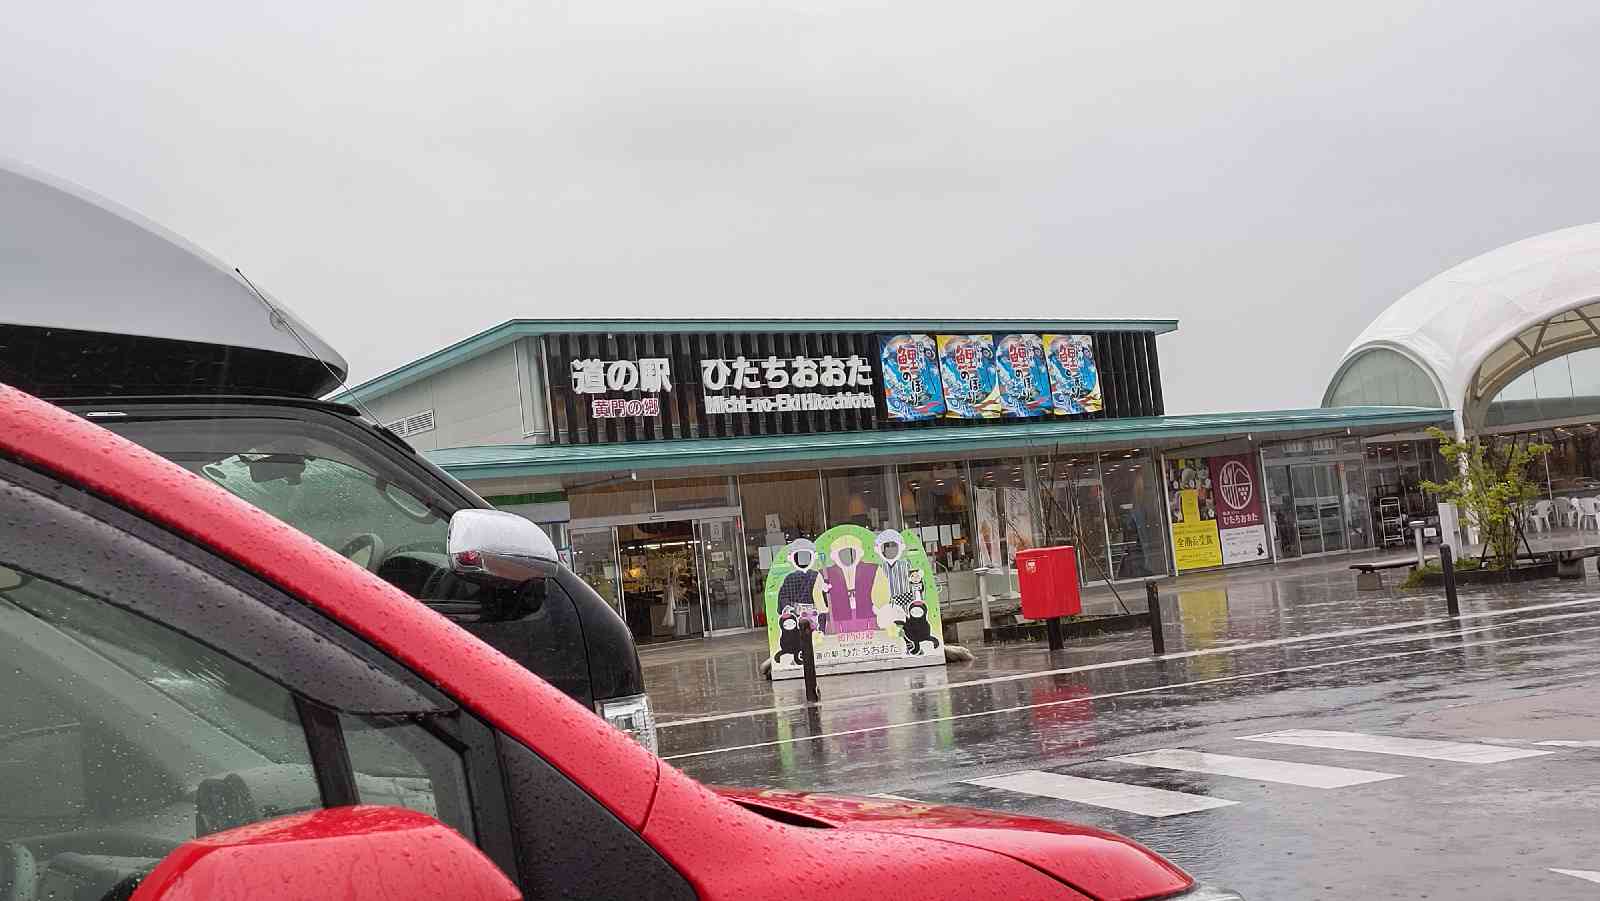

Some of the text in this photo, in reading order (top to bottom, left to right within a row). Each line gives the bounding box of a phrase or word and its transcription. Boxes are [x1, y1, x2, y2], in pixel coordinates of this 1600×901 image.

[570, 358, 672, 394] 道の駅
[700, 355, 873, 390] ひたちおおた
[592, 398, 660, 418] 黄門の郷
